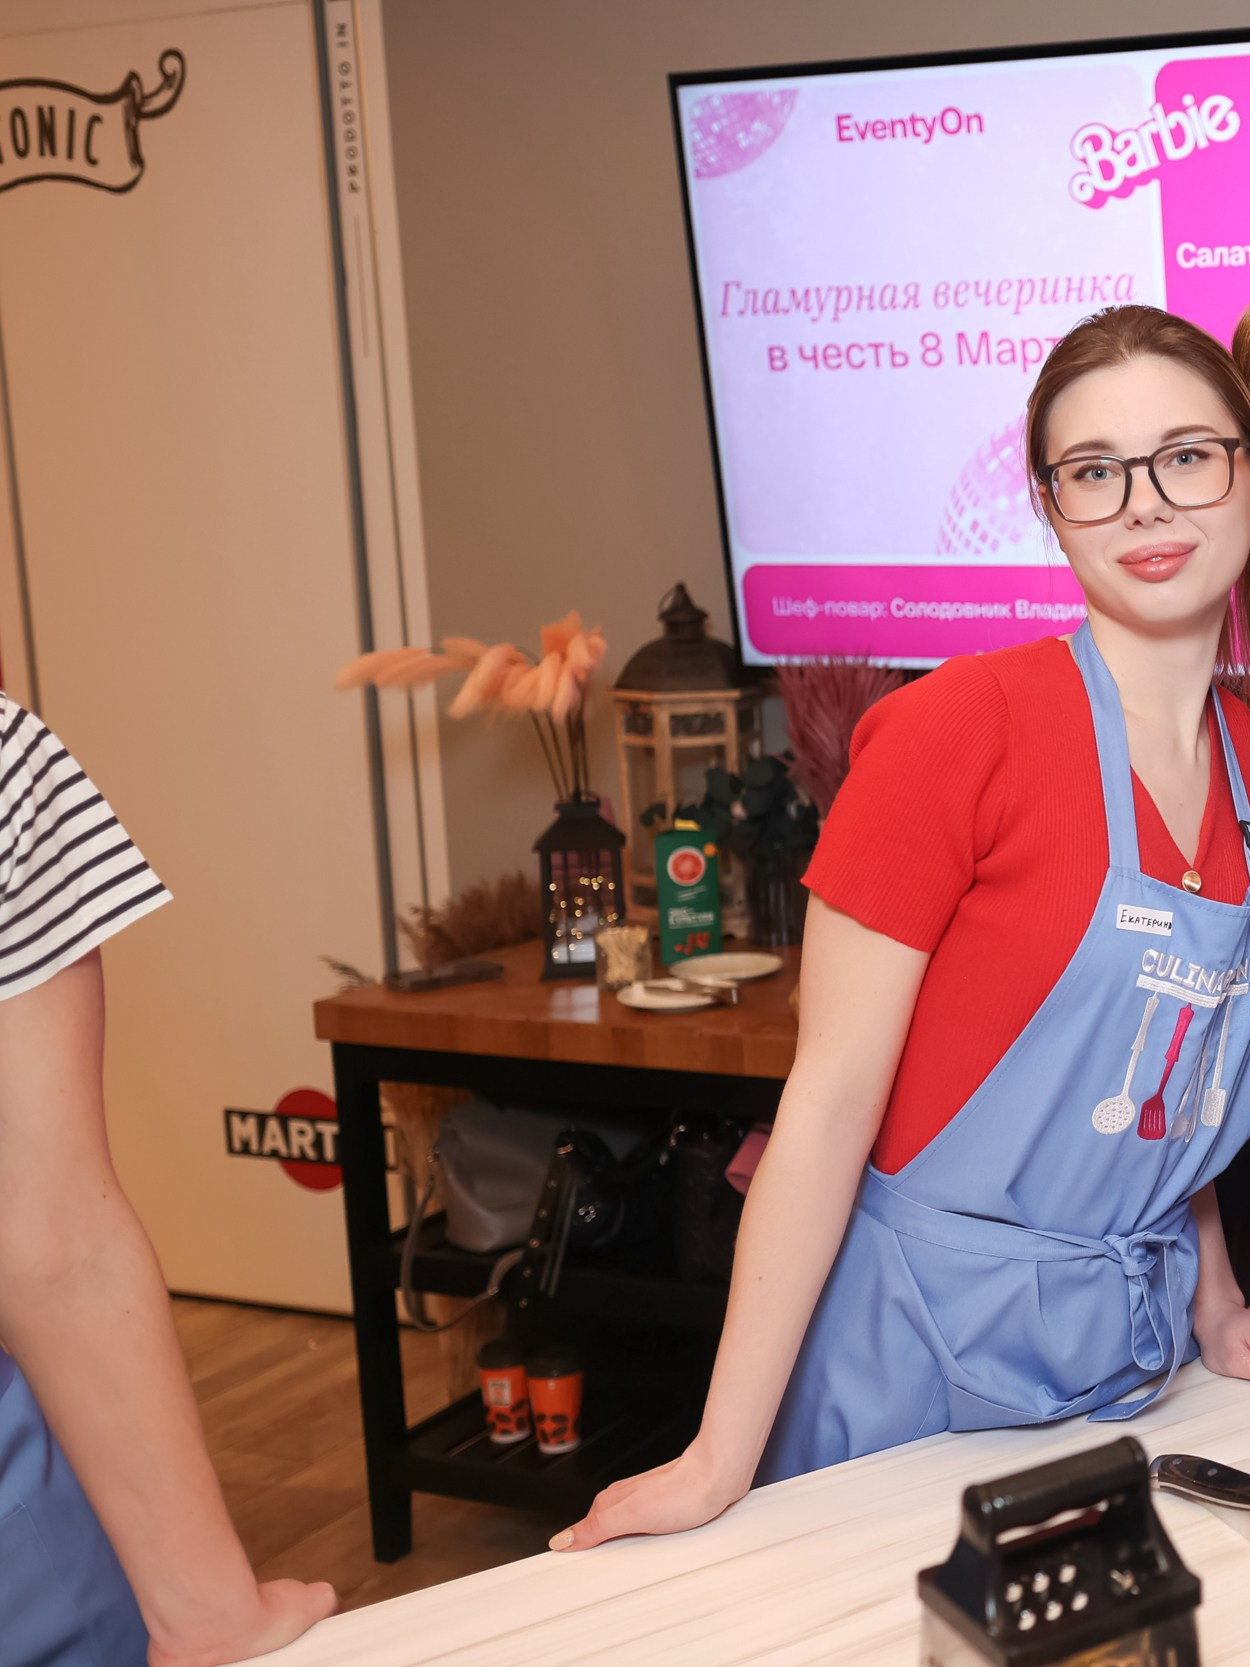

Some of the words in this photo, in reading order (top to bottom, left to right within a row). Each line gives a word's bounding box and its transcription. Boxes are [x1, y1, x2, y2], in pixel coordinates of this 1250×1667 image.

[0, 104, 103, 167] ONIC
[834, 107, 985, 144] EventyOn
[1070, 94, 1240, 204] Barbie
[720, 278, 924, 323] Гламурная
[933, 273, 1135, 314] вечеринка
[768, 346, 788, 373] в
[798, 340, 910, 370] честь
[919, 333, 944, 368] 8
[955, 330, 1063, 374] Март
[772, 596, 887, 621] Шеф-повар:
[890, 598, 1012, 620] Солодовник
[1014, 599, 1087, 622] Влади
